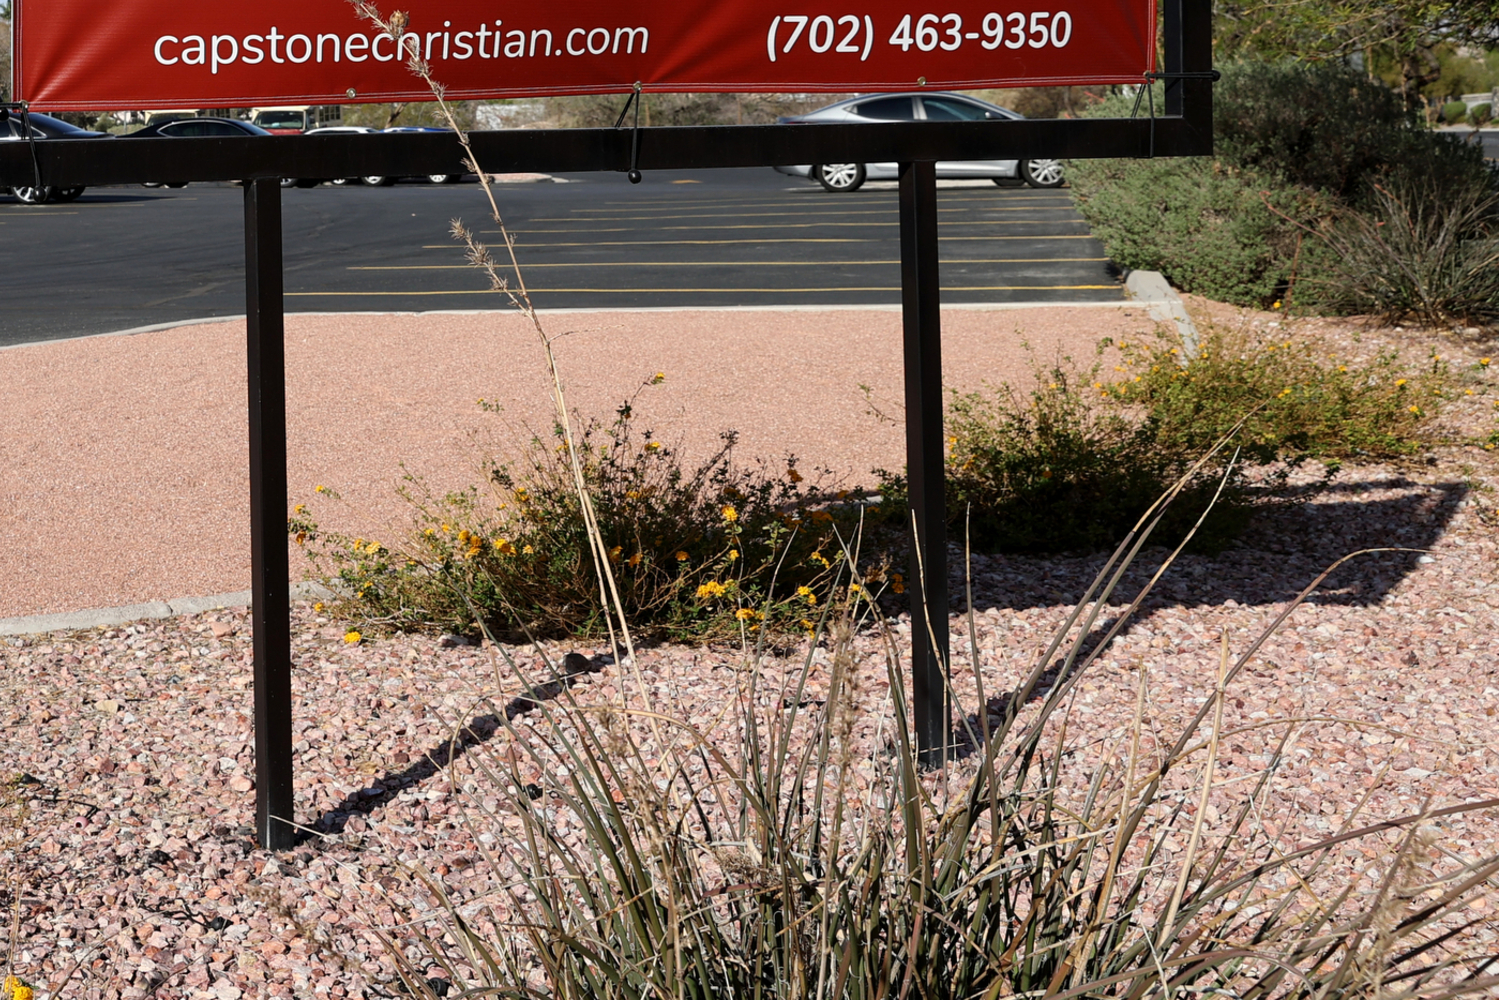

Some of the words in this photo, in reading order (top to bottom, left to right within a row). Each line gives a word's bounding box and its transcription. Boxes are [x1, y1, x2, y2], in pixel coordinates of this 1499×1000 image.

[153, 19, 650, 75] capstonechristian.com
[765, 14, 875, 63] (702)
[888, 10, 1073, 53] 463-9350
